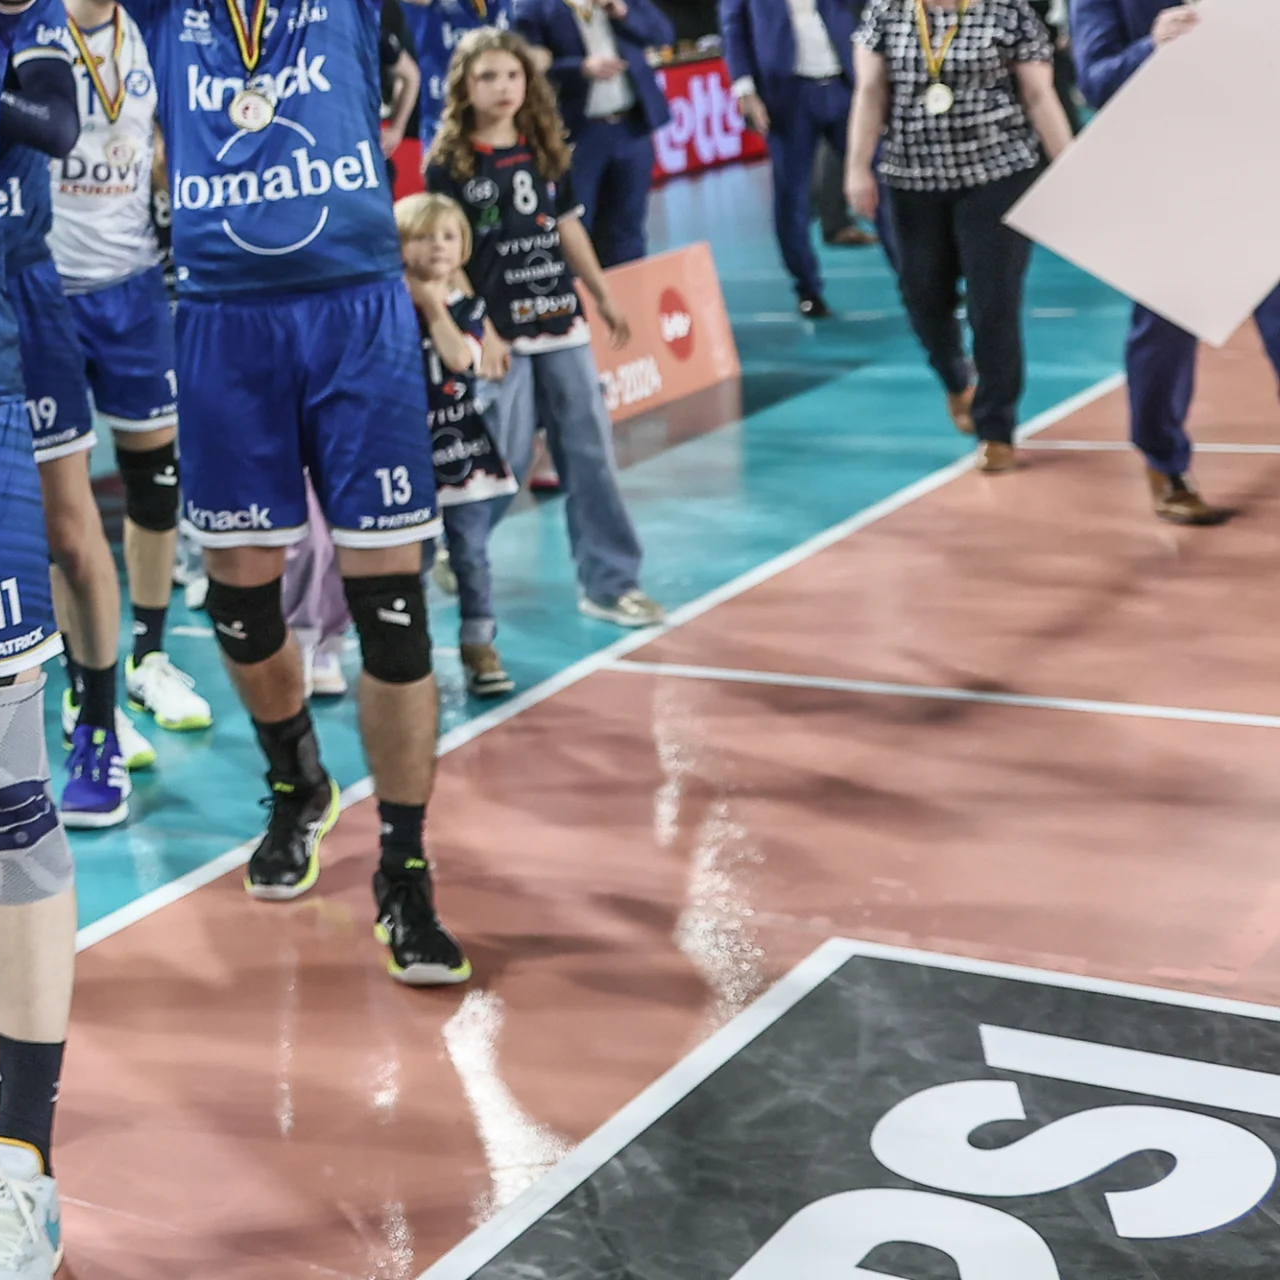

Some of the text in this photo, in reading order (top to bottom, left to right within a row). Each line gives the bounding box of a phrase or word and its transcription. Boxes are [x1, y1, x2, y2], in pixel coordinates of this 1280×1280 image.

[512, 169, 539, 215] 8
[26, 396, 58, 432] 19
[374, 465, 413, 507] 13
[188, 500, 273, 531] knack
